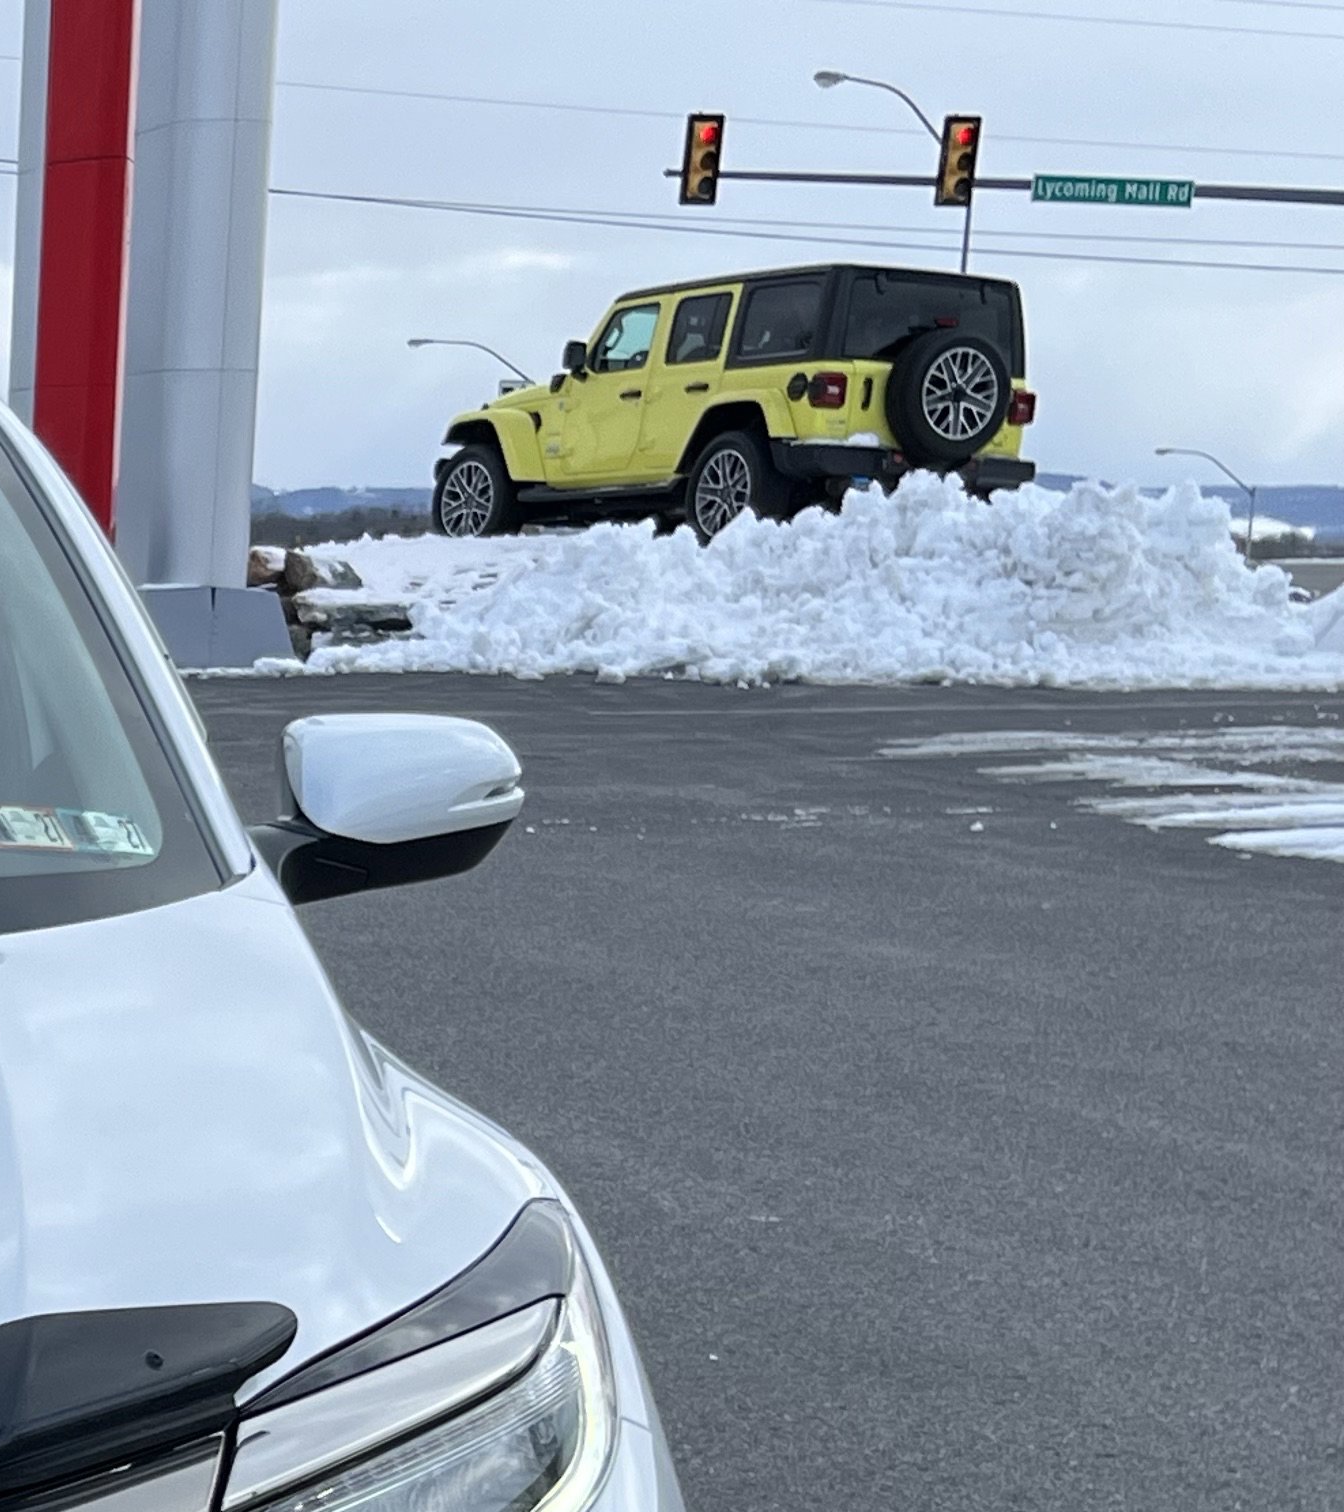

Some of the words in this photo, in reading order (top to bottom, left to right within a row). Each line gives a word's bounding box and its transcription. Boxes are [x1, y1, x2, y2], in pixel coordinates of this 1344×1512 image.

[1037, 178, 1118, 202] Lycoming
[1124, 181, 1161, 201] Mall
[1166, 183, 1190, 201] Rd
